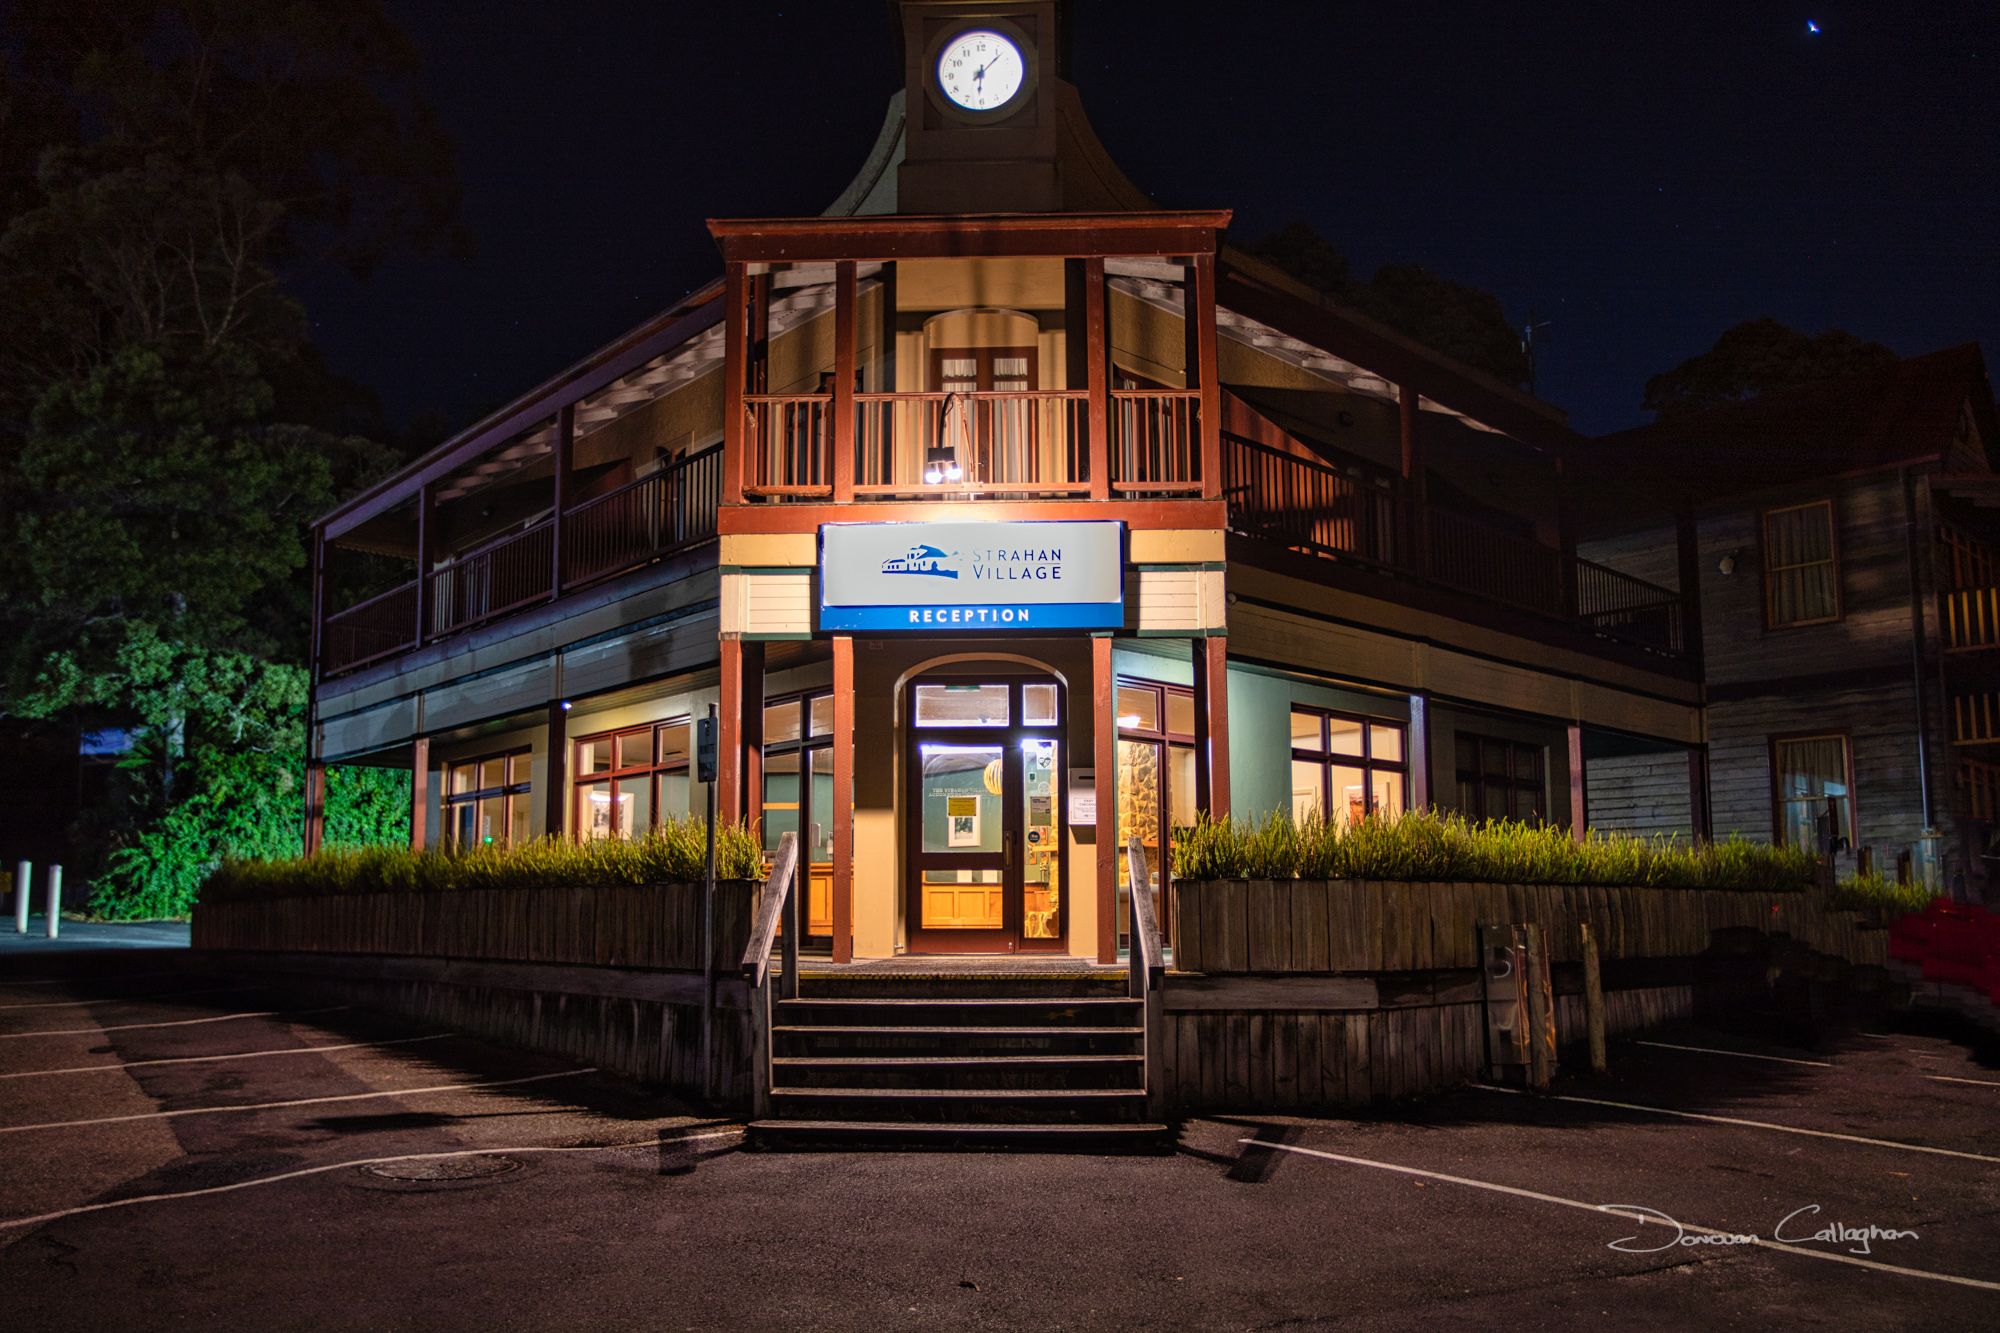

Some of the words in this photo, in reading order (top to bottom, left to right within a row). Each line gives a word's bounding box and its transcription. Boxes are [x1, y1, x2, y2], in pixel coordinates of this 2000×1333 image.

[976, 44, 986, 52] 12
[963, 49, 971, 57] 11
[952, 59, 963, 68] 10
[953, 85, 959, 93] 8
[965, 95, 970, 103] 7
[973, 548, 1061, 562] STRAHAN
[973, 564, 1061, 580] VILLAGE
[909, 609, 1029, 623] RECEPTION
